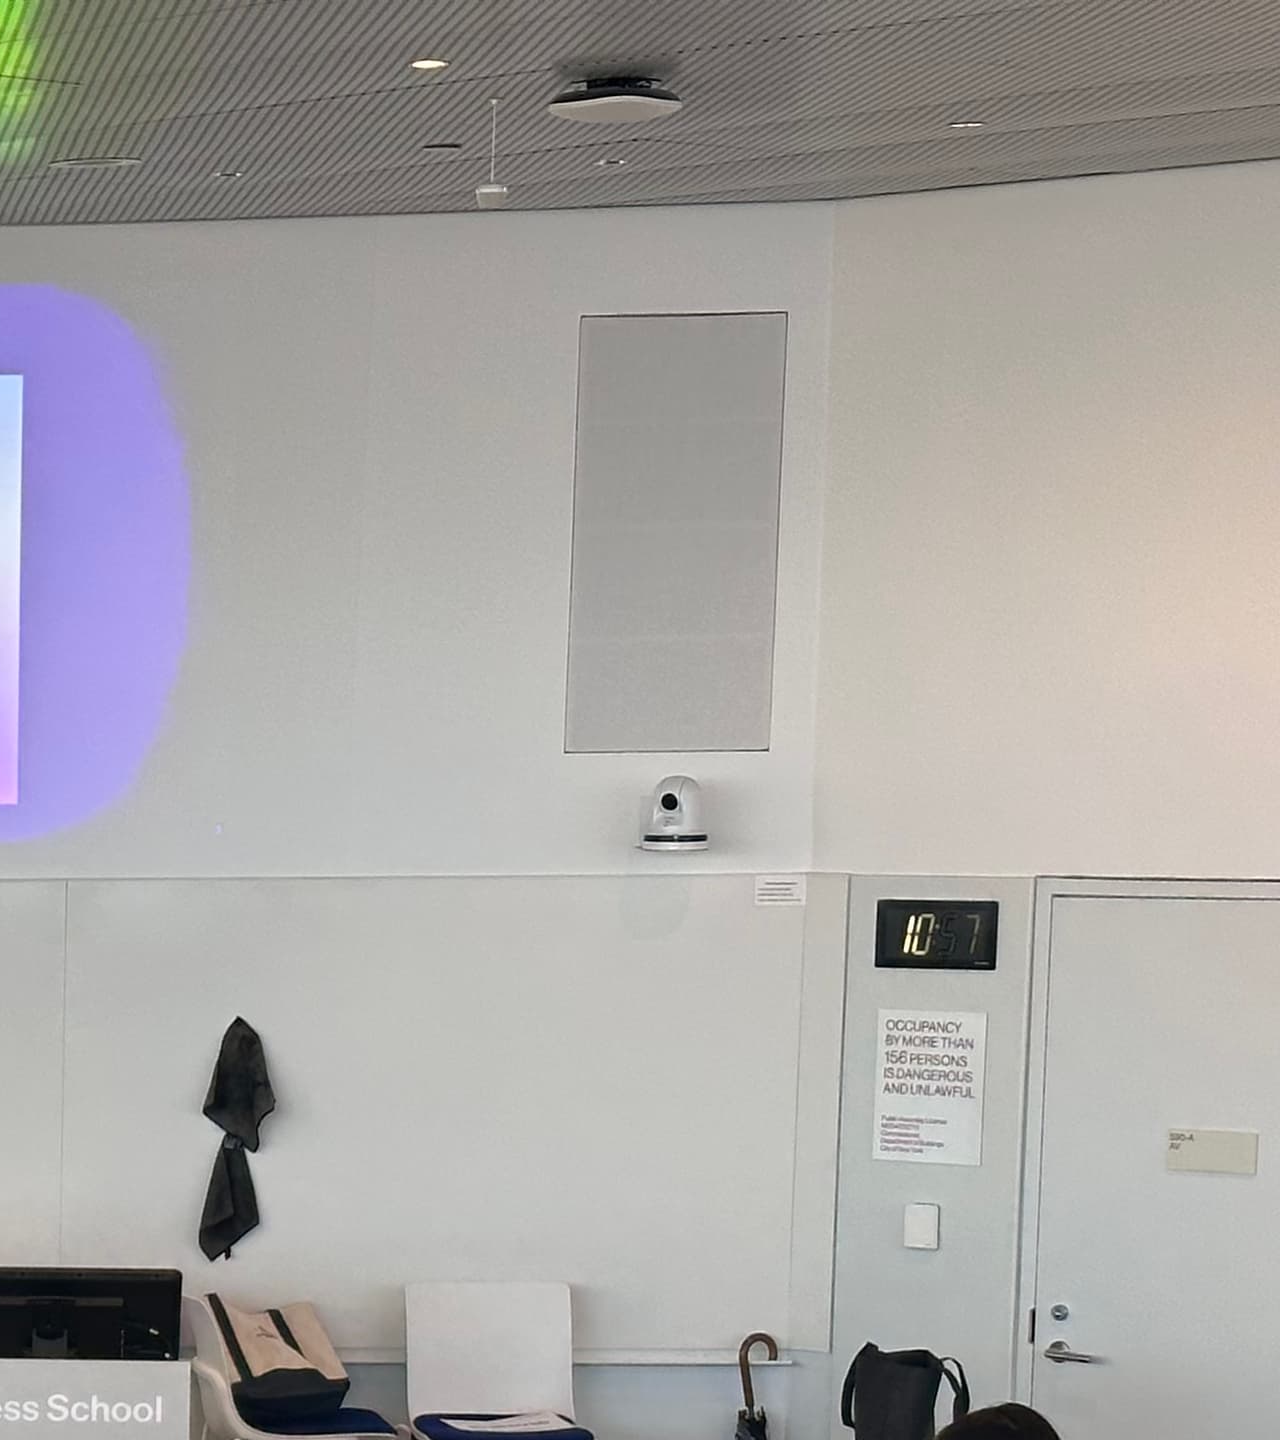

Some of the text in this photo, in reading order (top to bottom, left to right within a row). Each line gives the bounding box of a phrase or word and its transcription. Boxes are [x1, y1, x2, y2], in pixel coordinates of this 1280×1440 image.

[885, 1019, 962, 1034] OCCUPANCY
[884, 1034, 974, 1049] BY MORE THAN
[884, 1050, 968, 1067] 156 PERSONS
[883, 1067, 973, 1083] IS DANGEROUS
[883, 1083, 976, 1099] AND UNLAWFUL
[46, 1393, 163, 1423] School
